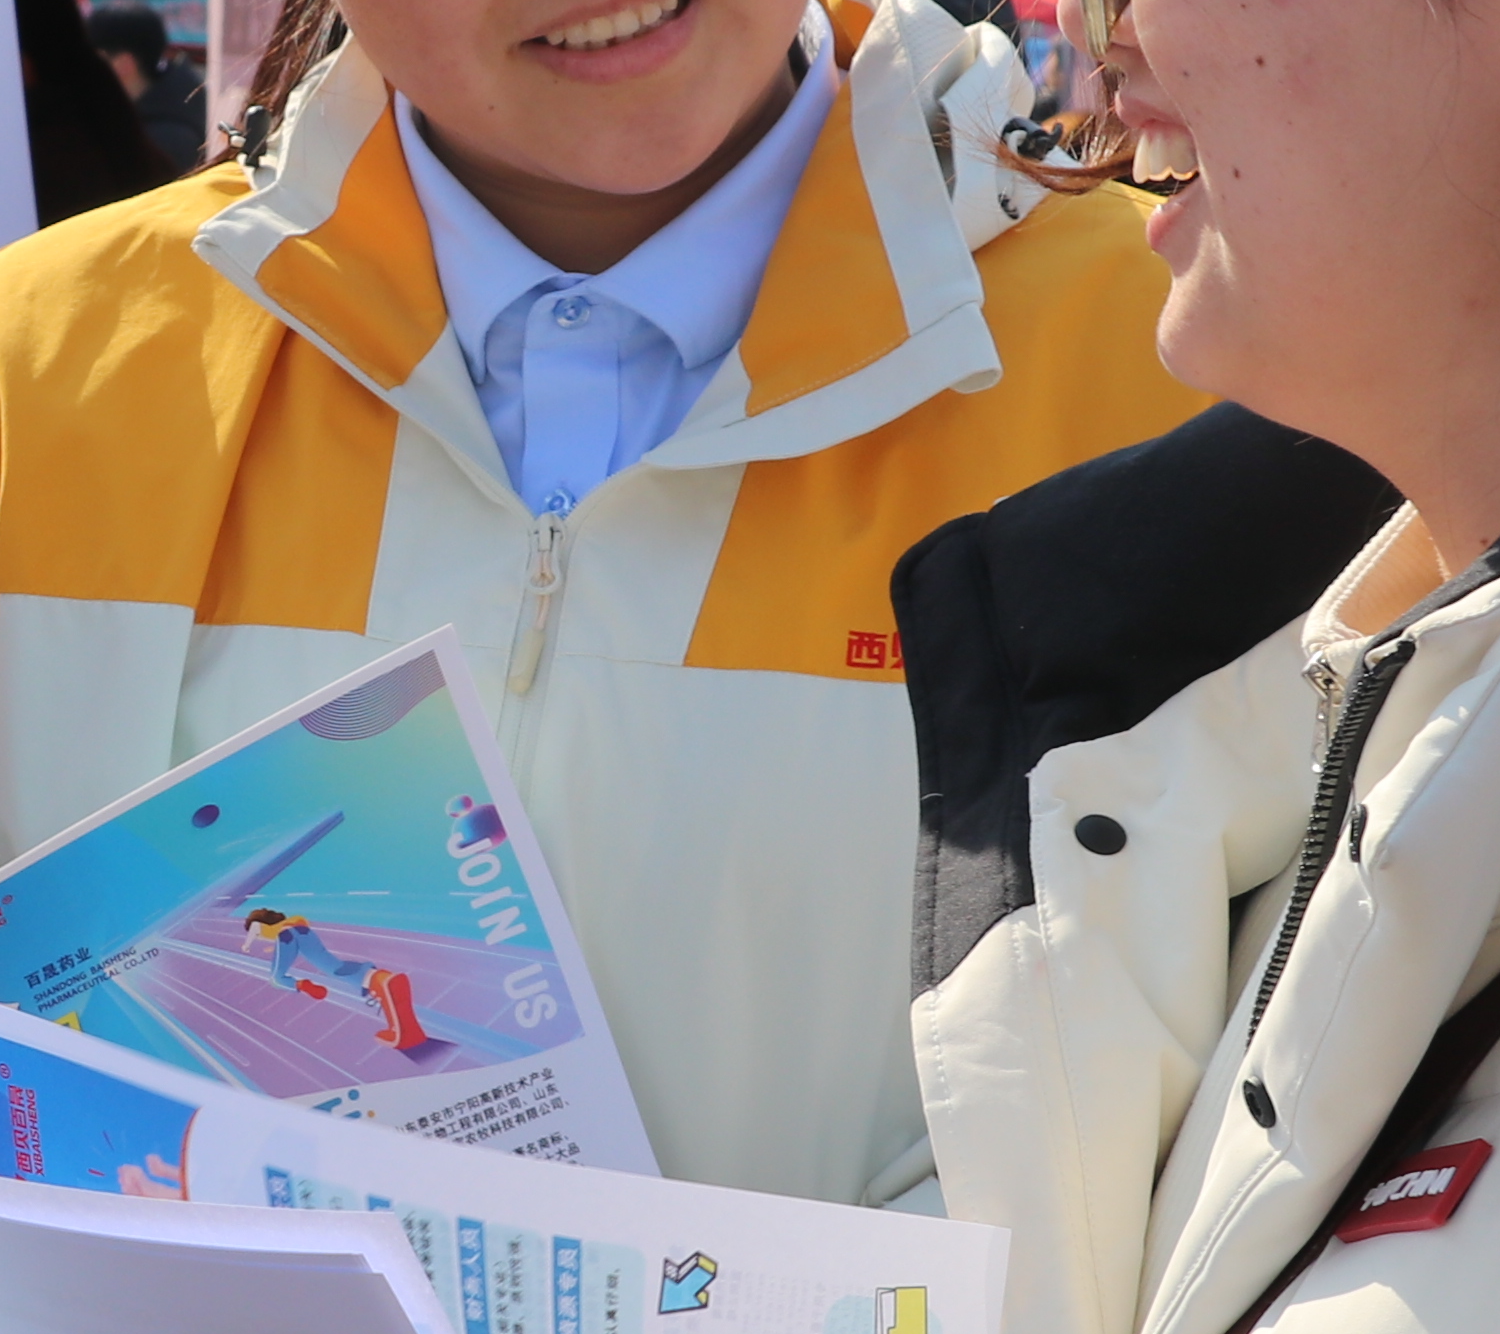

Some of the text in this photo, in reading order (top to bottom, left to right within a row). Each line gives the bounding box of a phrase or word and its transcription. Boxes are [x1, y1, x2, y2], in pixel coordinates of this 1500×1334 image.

[446, 828, 560, 1032] JOIN US
[23, 946, 93, 989] 百晟药业
[32, 946, 138, 1003] SHANDONG BAISHENG
[37, 968, 121, 1014] PHARMACEUTICAL
[25, 1088, 46, 1177] XIBAISHENG
[422, 1082, 560, 1140] 物工程有限公司、山东
